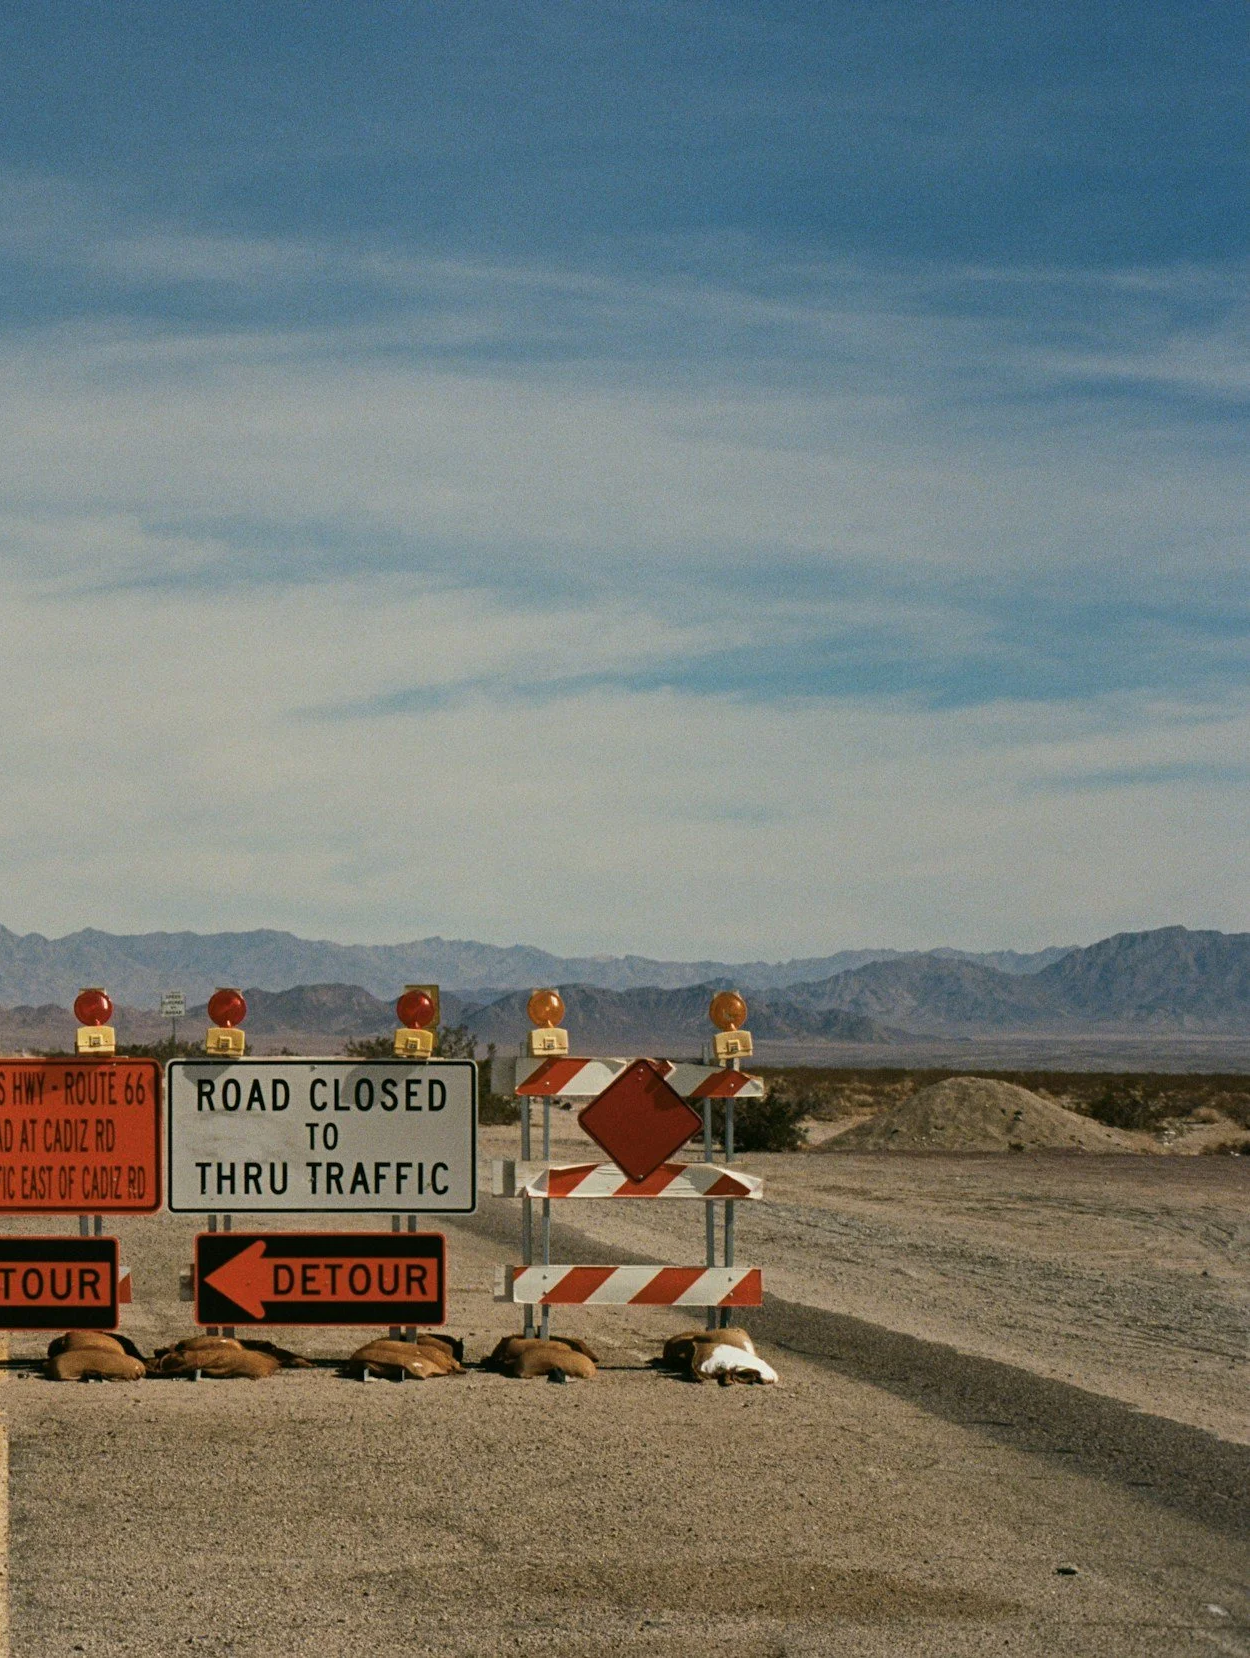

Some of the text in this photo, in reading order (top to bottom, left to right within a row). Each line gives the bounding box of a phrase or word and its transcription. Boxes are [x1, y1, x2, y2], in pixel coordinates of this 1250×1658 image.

[13, 1072, 45, 1105] HWY
[65, 1072, 117, 1105] ROUTE
[125, 1073, 146, 1105] 66
[197, 1079, 447, 1112] ROAD CLOSED
[20, 1119, 37, 1153] AT
[43, 1119, 88, 1153] CADIZ
[96, 1119, 115, 1153] RD
[306, 1123, 338, 1150] TO
[21, 1166, 55, 1200] EAST
[59, 1166, 74, 1200] OF
[80, 1166, 122, 1200] CADIZ
[128, 1166, 146, 1200] RD
[196, 1162, 449, 1195] THRU TRAFFIC
[274, 1264, 428, 1296] DETOUR
